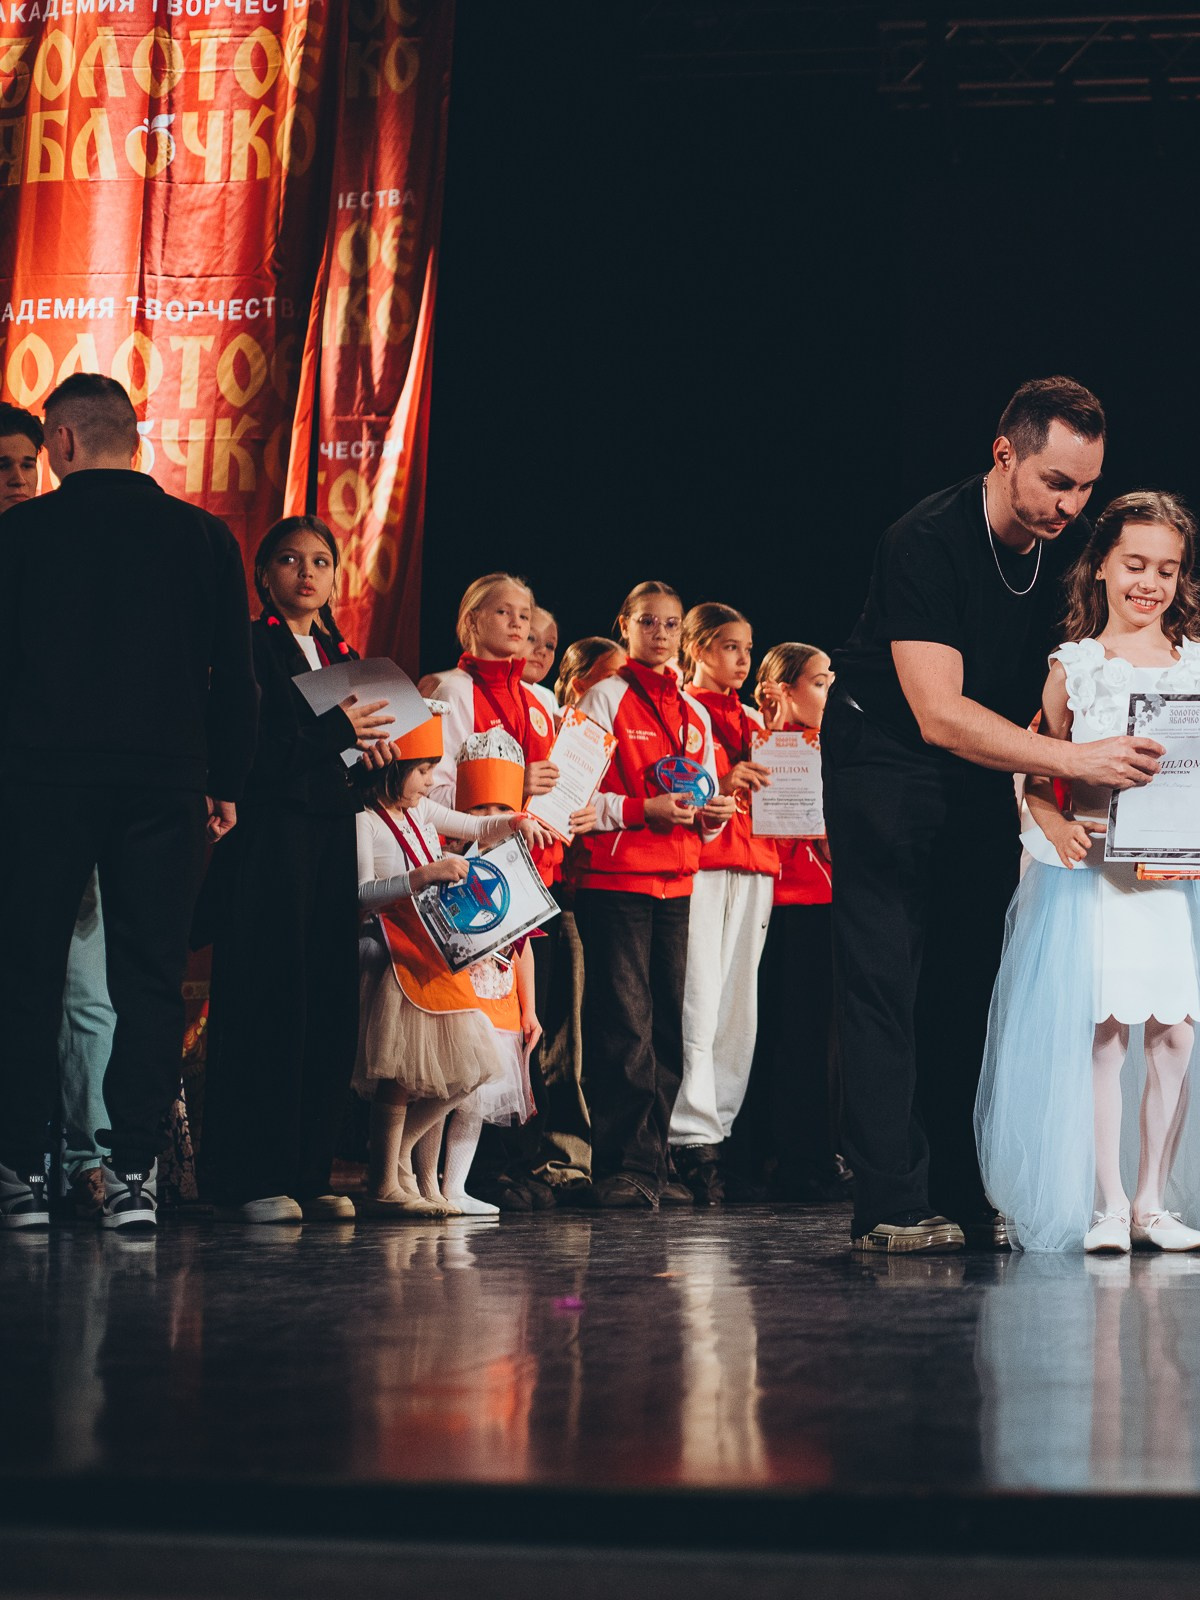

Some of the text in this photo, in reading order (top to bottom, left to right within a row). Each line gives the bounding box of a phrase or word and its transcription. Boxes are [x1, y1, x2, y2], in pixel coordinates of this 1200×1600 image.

[765, 766, 809, 774] ИПЛОМ
[29, 1175, 44, 1183] NIKE
[126, 1173, 142, 1181] NIKE
